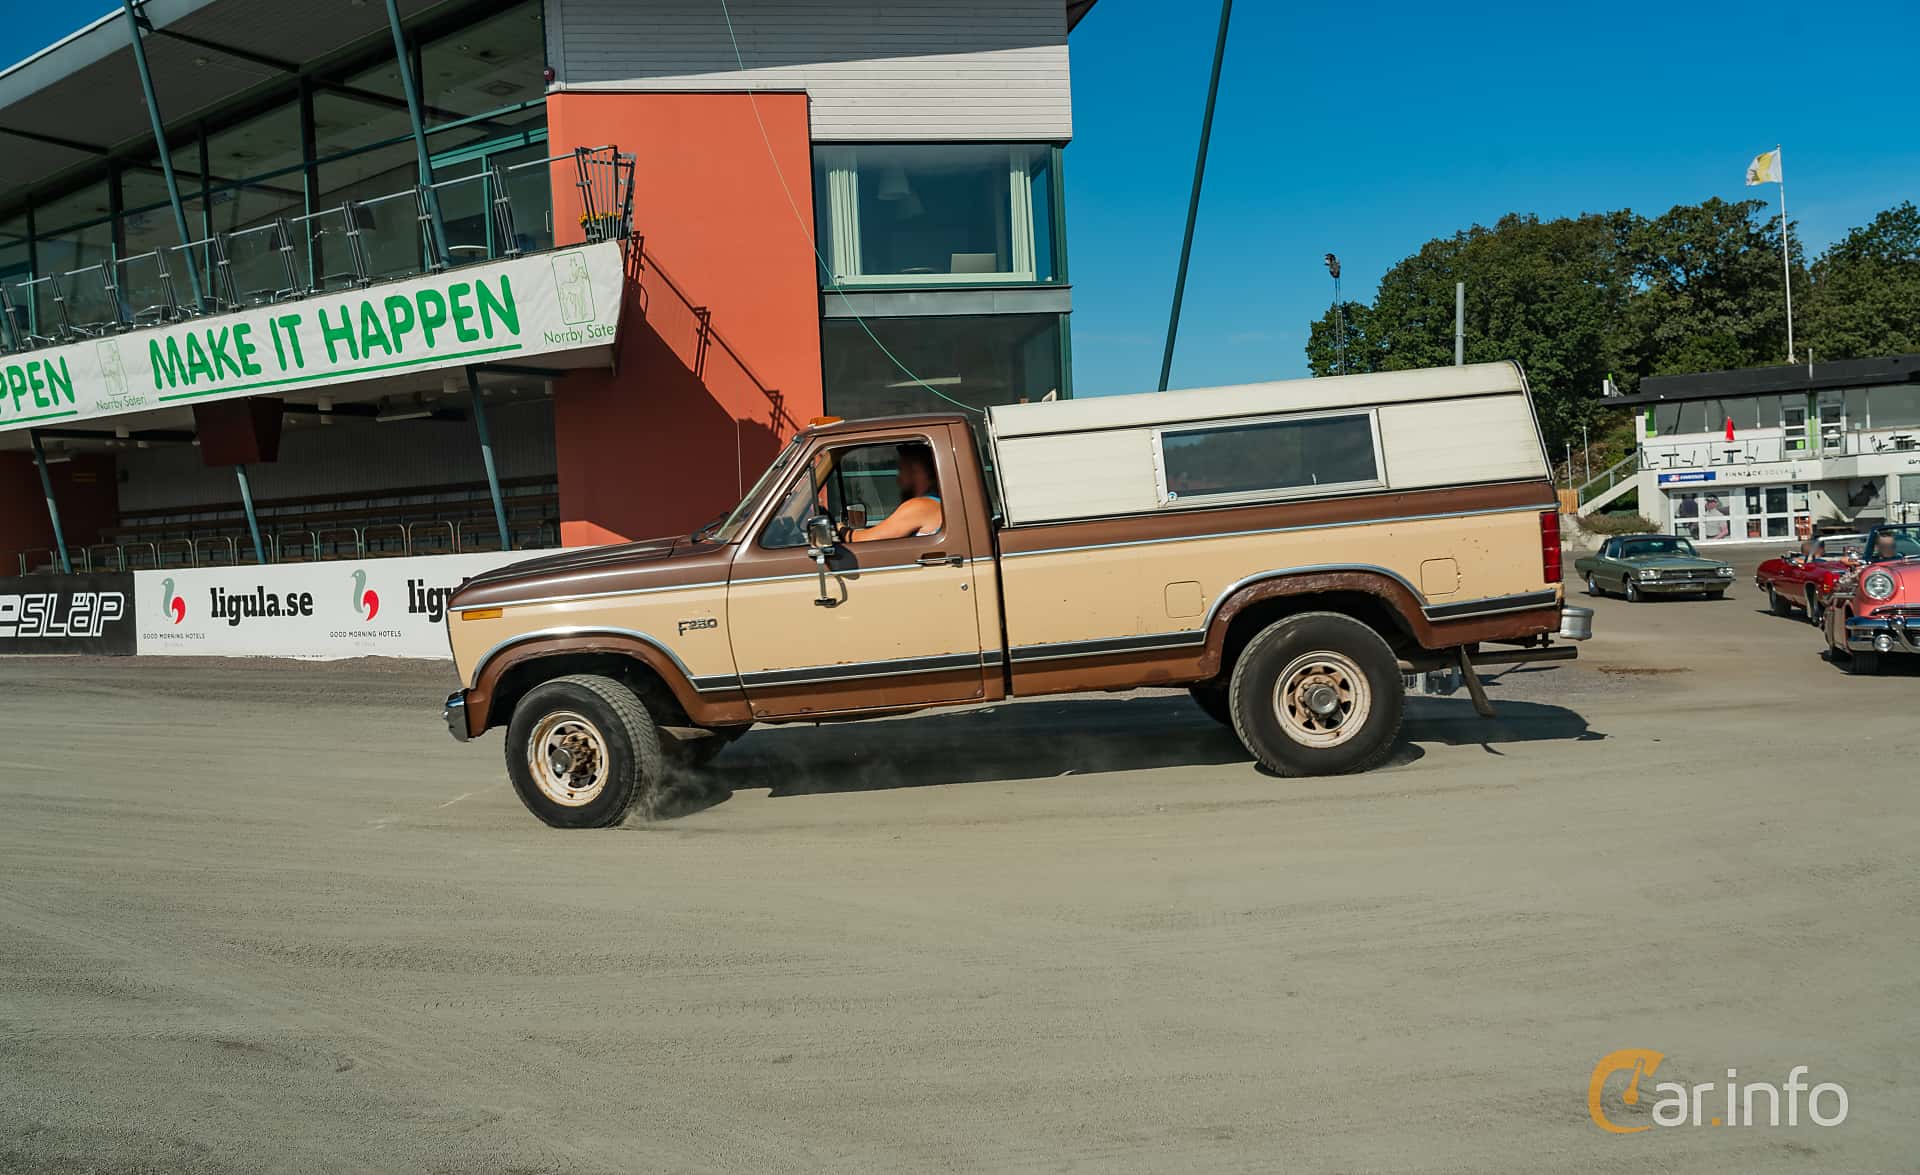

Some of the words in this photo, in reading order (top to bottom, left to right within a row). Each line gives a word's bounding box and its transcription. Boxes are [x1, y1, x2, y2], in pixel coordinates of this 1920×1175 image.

[149, 322, 262, 390] MAKE
[269, 313, 304, 371] IT
[318, 274, 520, 363] HAPPEN
[543, 327, 583, 345] Norrby
[96, 397, 122, 410] Norrby
[210, 585, 313, 626] ligula.se
[159, 632, 184, 640] MORNING
[185, 632, 206, 640] HOTELS
[348, 630, 377, 638] MORNING
[378, 630, 402, 638] HOTELS
